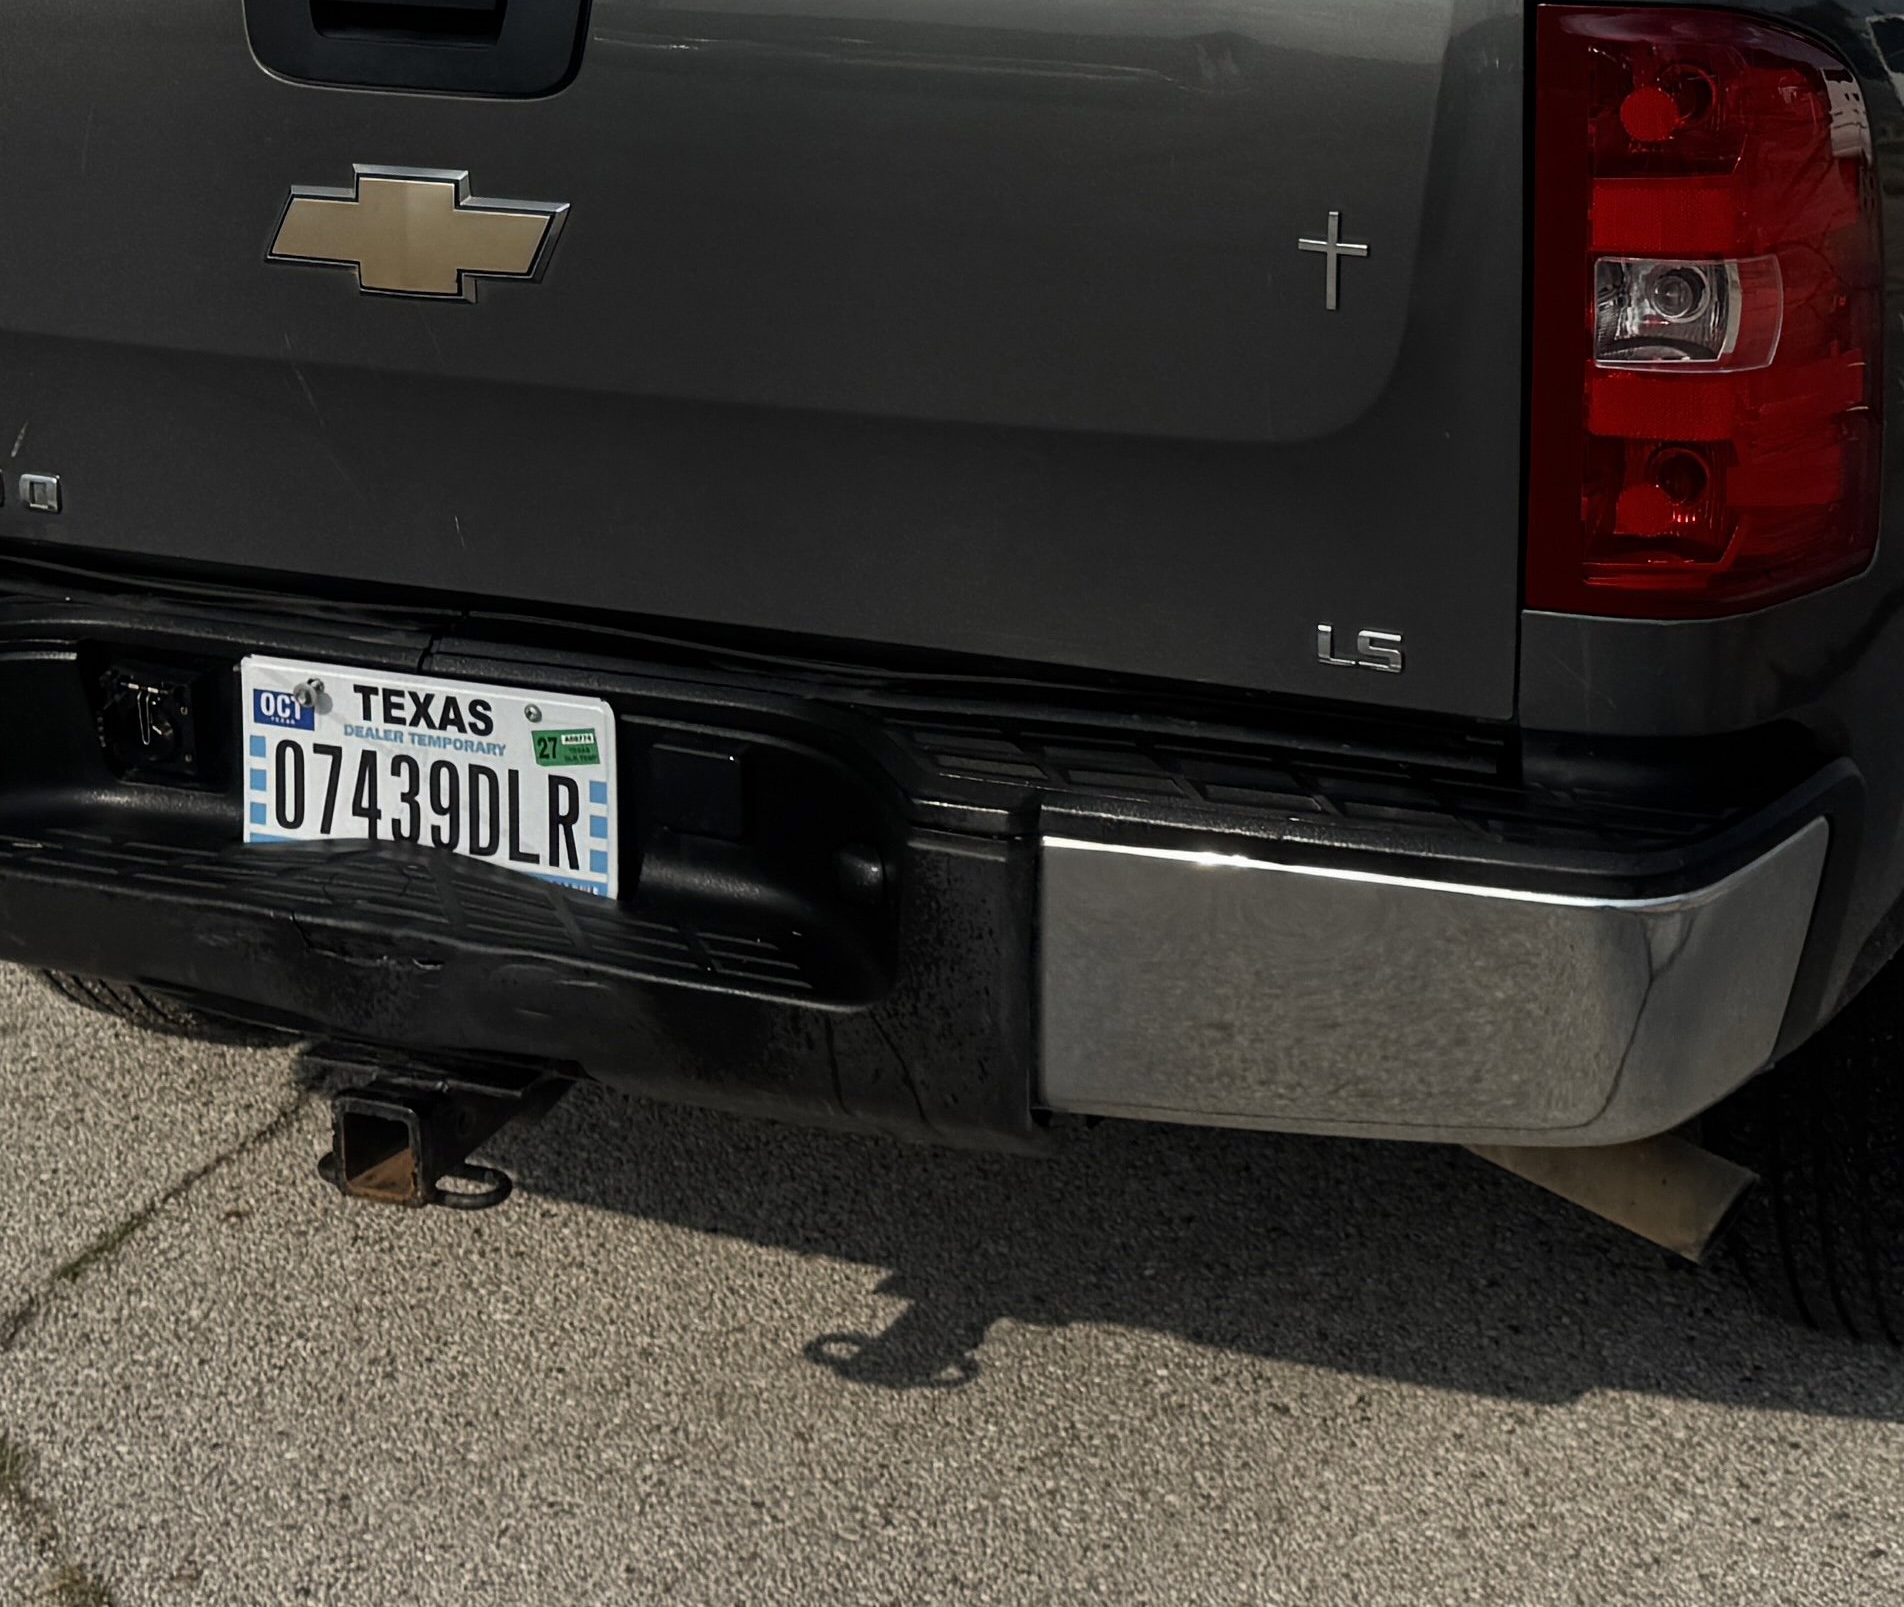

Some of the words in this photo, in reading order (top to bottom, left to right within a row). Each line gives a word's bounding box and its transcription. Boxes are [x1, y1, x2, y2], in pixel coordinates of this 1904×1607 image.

[1317, 624, 1402, 674] LS
[353, 684, 494, 736] TEXAS
[344, 724, 404, 744] DEALER
[408, 732, 507, 757] TEMPORARY
[537, 736, 558, 759] 27
[275, 739, 580, 871] 07439DLR
